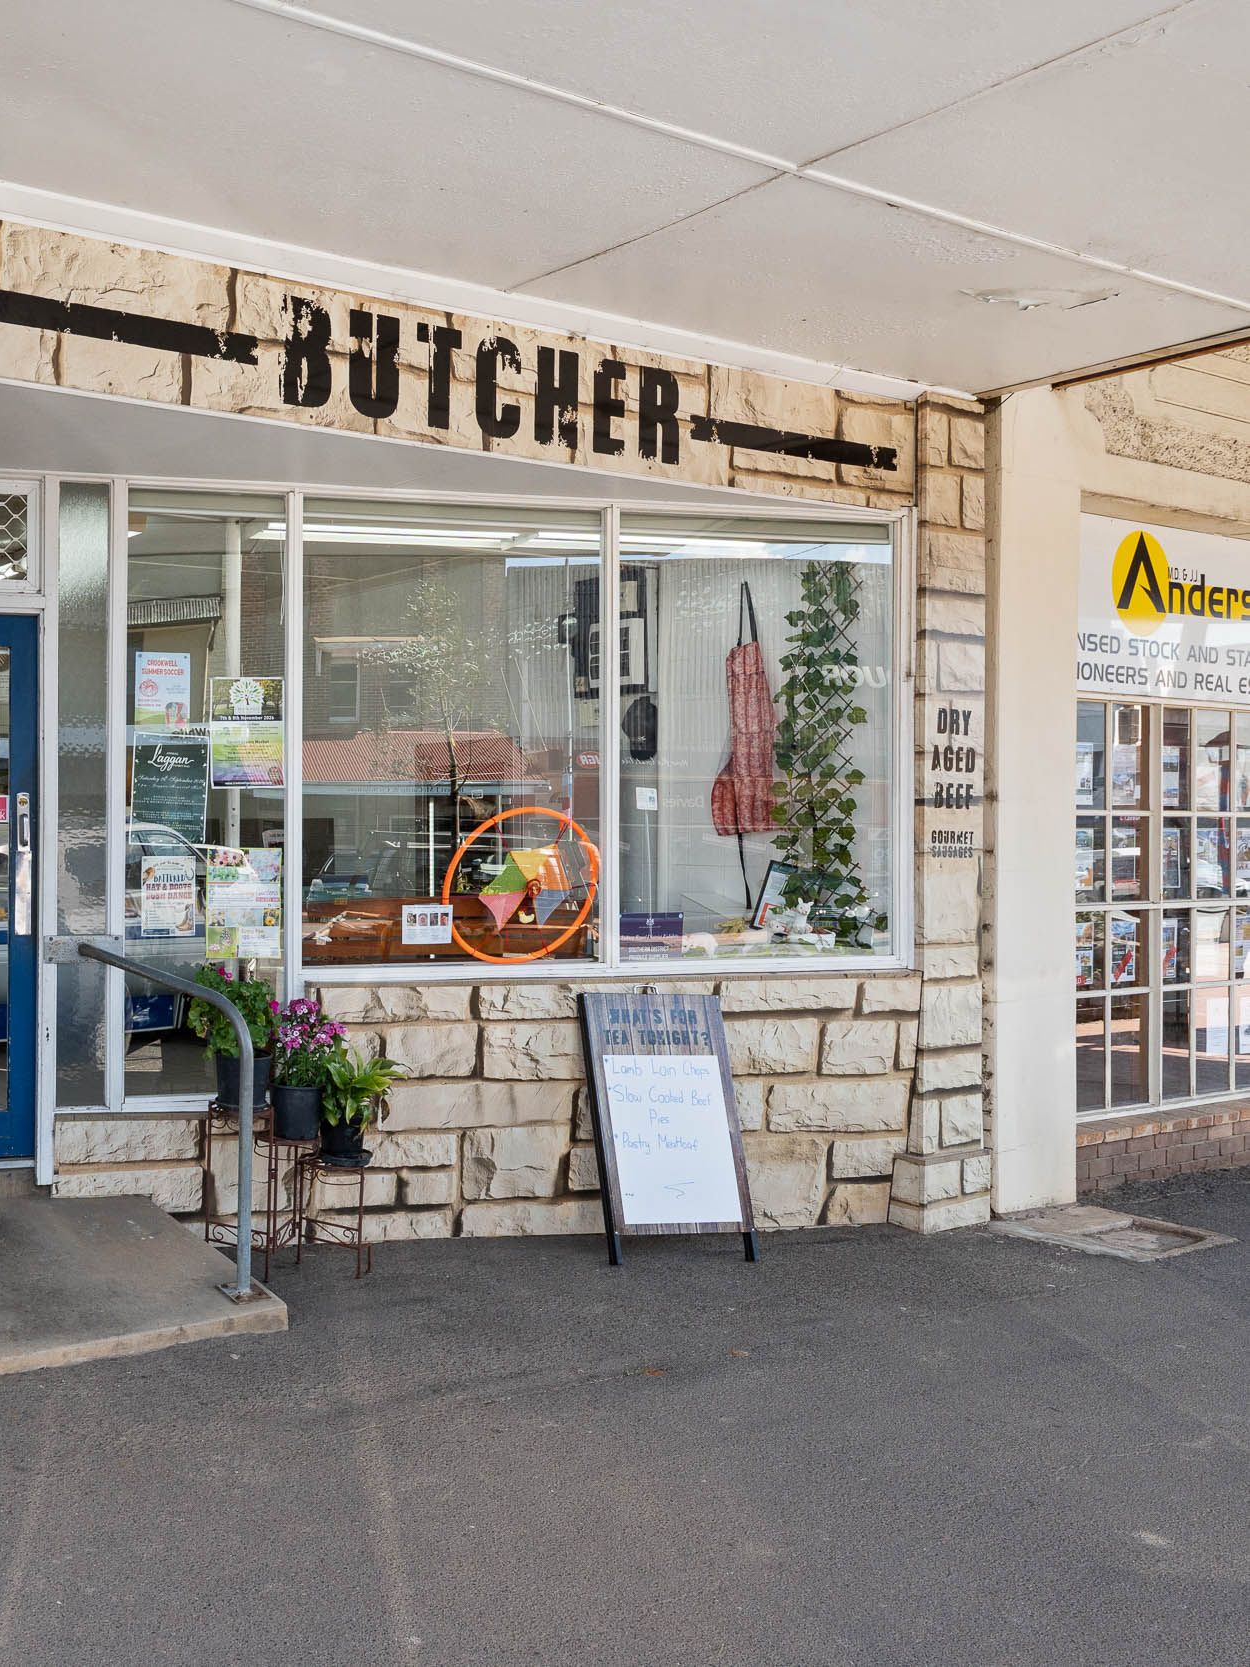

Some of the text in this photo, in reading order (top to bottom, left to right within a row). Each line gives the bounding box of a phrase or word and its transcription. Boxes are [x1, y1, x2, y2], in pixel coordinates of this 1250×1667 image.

[278, 295, 680, 465] BUTCHER
[1128, 638, 1180, 661] STOCK
[1186, 645, 1219, 664] AND
[1155, 669, 1188, 689] AND
[1194, 673, 1232, 693] REAL
[936, 707, 972, 736] DRY
[147, 743, 195, 772] Laggan
[931, 744, 976, 773] AGED
[934, 782, 974, 810] BEEF
[931, 830, 975, 845] GOURMET
[931, 845, 974, 859] SAUSAGES
[669, 1009, 697, 1026] FOR
[603, 1029, 711, 1047] TEA TONIGHT?
[611, 1059, 643, 1077] Lamb
[613, 1084, 712, 1105] Slow Cooked Beef
[649, 1109, 670, 1125] Pies
[622, 1132, 651, 1155] Pastry
